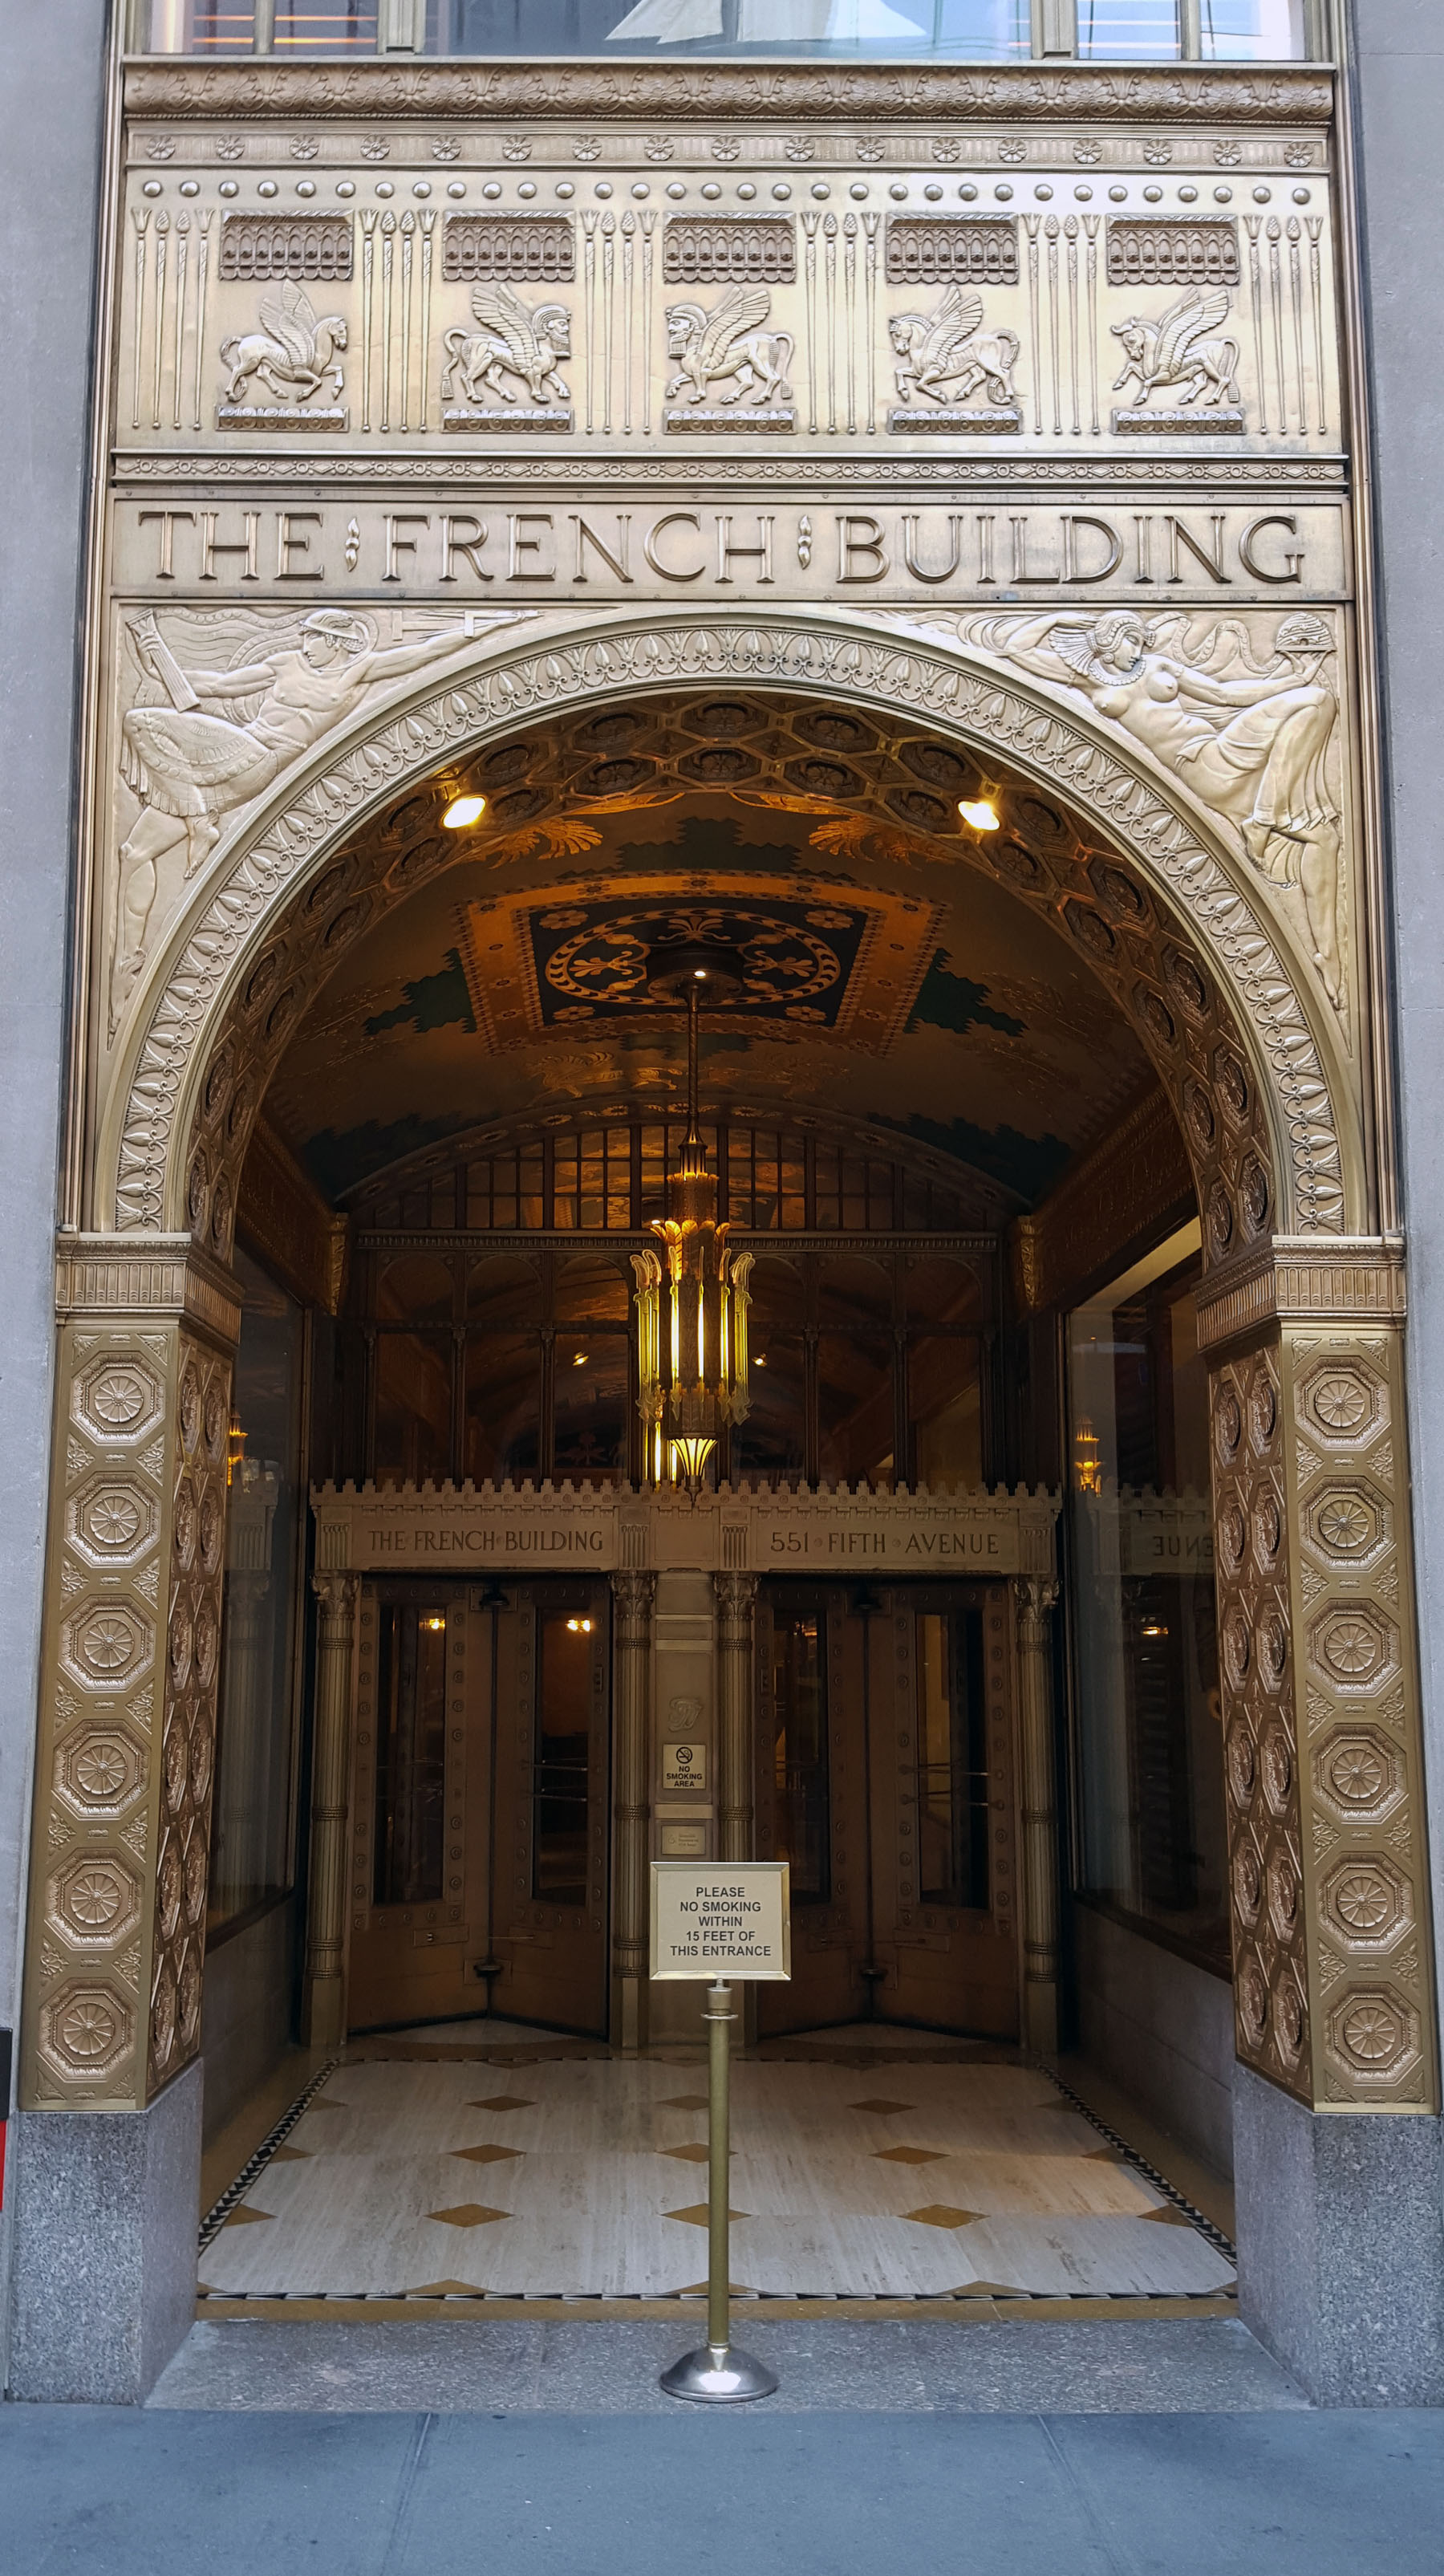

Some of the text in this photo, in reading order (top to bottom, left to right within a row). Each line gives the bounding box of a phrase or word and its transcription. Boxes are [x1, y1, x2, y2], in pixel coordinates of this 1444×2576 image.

[138, 510, 1305, 584] THE FRENCH BUILDING
[368, 1530, 604, 1551] THE FRENCH BUILDING
[770, 1531, 1000, 1554] 551 FIFTH AVENUE
[696, 1887, 745, 1897] PLEASE
[679, 1901, 761, 1912] NO SMOKING
[698, 1916, 743, 1927] WITHIN
[686, 1931, 756, 1941] 15 FEET OF
[670, 1945, 772, 1956] THIS ENTRANCE
